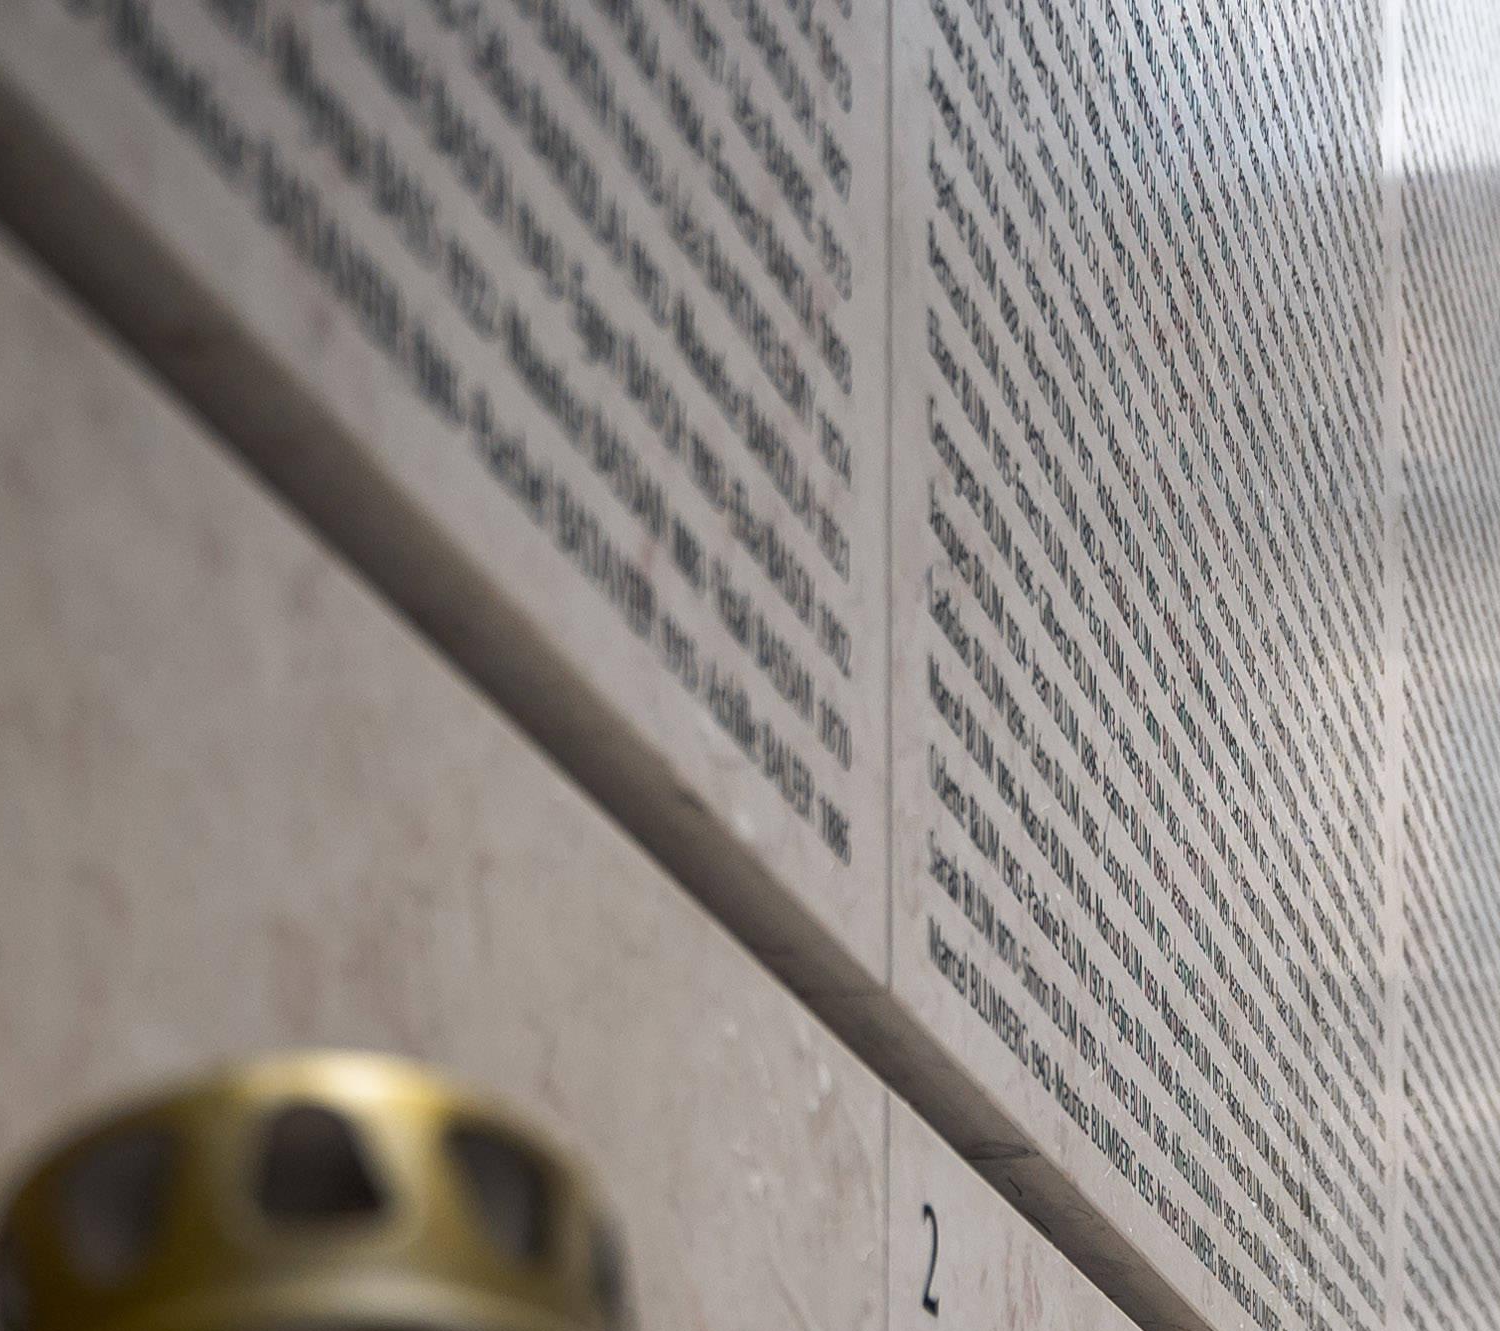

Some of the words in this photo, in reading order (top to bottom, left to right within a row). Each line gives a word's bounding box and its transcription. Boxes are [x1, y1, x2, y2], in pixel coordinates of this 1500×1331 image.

[1049, 66, 1079, 175] BLOCH
[1035, 112, 1066, 220] Simon
[1067, 183, 1099, 293] BLOCH
[970, 295, 999, 394] BLUM
[1048, 290, 1086, 407] BLONDEL
[961, 361, 990, 458] BLUM
[982, 483, 1012, 577] BLUM
[973, 550, 1004, 644] BLUM
[973, 634, 1004, 726] BLUM
[1102, 829, 1133, 922] Leopold
[928, 648, 962, 745] Marcel
[965, 702, 994, 789] BLUM
[1019, 780, 1048, 865] Marcel
[1160, 983, 1193, 1073] Marguerite
[968, 792, 999, 879] BLUM
[1026, 870, 1059, 956] Pauline
[928, 913, 967, 1005] Marcel
[969, 960, 1028, 1072] BLUMBERG
[1054, 1058, 1089, 1138] Maurice
[1090, 1099, 1136, 1191] BLUMBERG
[1180, 1203, 1216, 1280] BLUMBERG
[963, 868, 994, 953] BLUM
[1021, 941, 1050, 1020] Simon
[1100, 1040, 1128, 1114] Yvonne
[1191, 1153, 1222, 1226] BLUMANN
[922, 1202, 939, 1318] 2
